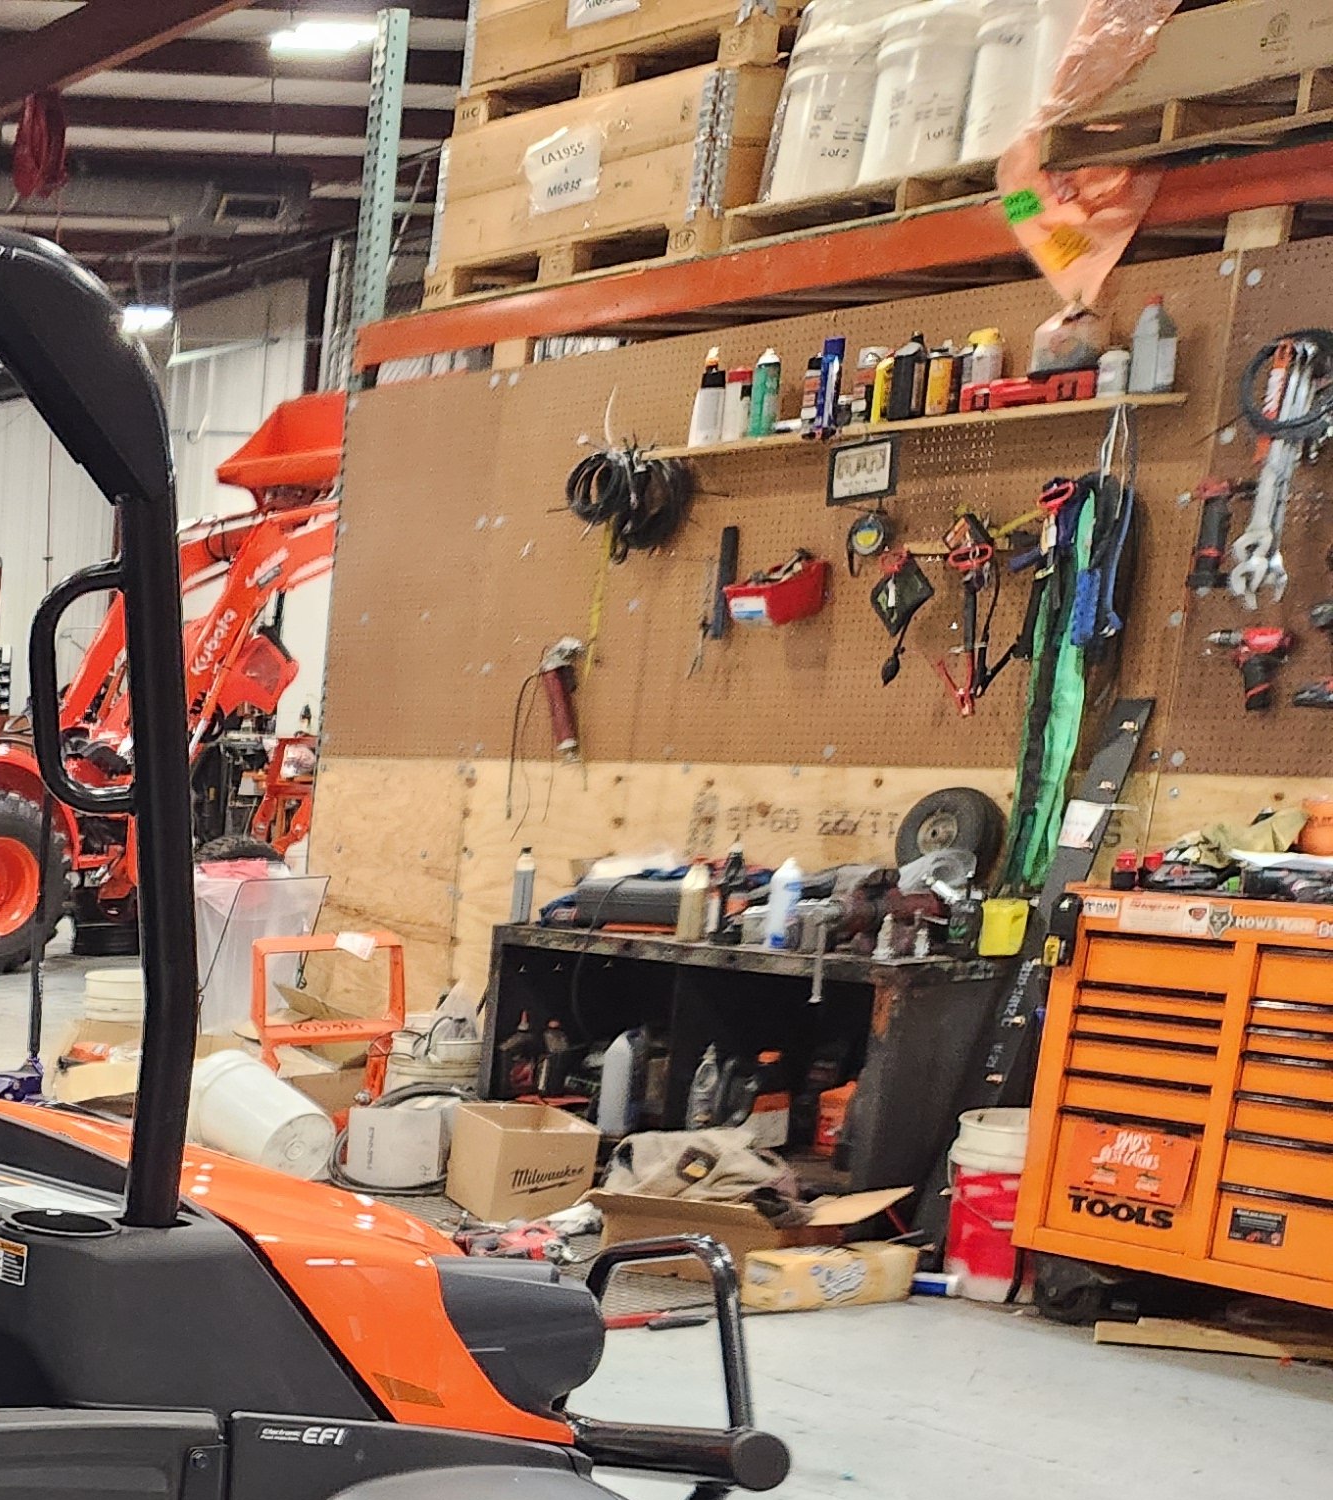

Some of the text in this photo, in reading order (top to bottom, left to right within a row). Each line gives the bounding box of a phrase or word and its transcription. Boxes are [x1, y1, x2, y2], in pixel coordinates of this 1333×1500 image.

[190, 608, 238, 676] Kubota
[509, 1164, 585, 1189] Milwaukee
[1068, 1193, 1174, 1230] TOOLS
[302, 1426, 345, 1446] EFI
